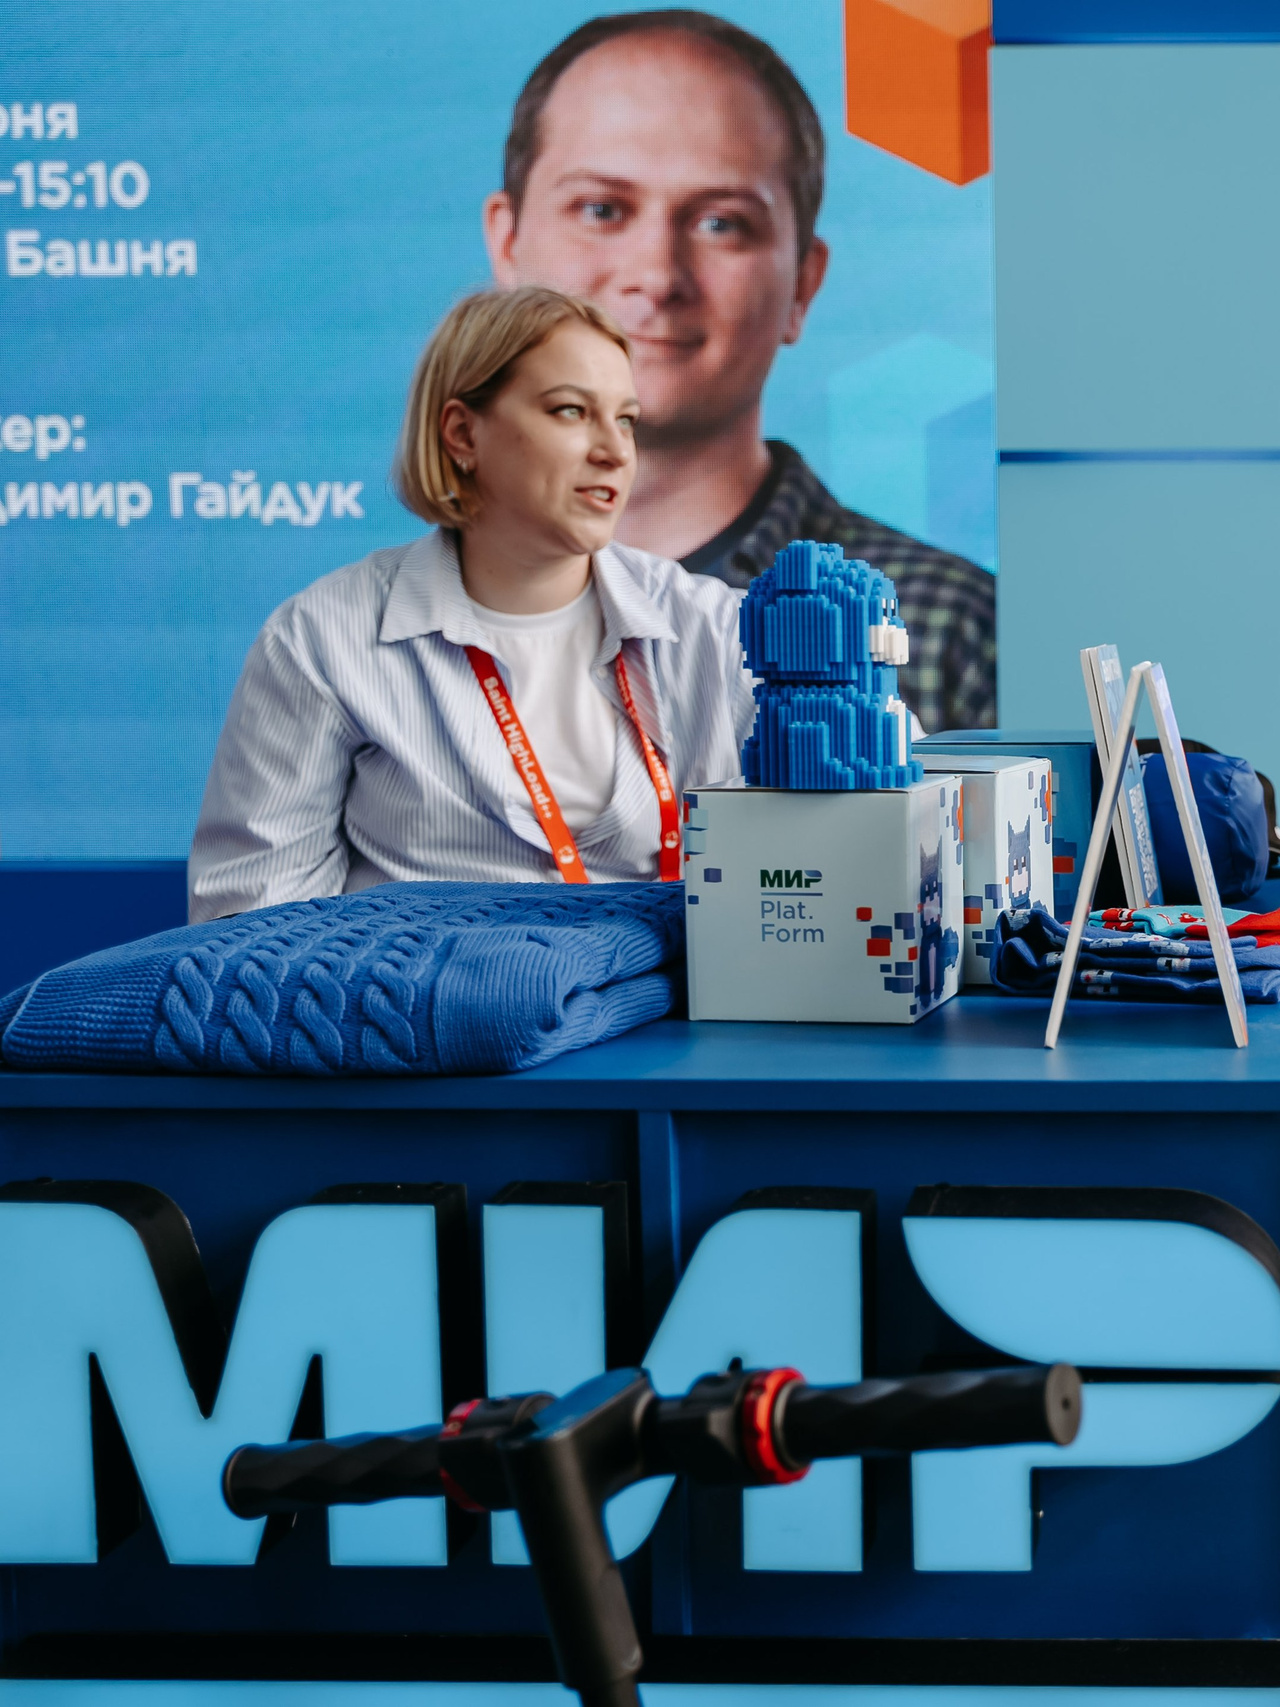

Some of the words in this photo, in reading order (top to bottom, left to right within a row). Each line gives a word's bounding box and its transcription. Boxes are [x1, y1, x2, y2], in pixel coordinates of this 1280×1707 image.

[0, 101, 79, 139] ня
[5, 229, 198, 277] Башня
[0, 413, 87, 461] ер:
[0, 481, 153, 528] имир
[169, 470, 365, 527] Гайдук
[483, 676, 512, 723] Saint
[503, 722, 552, 819] HighLoad++
[760, 869, 823, 888] МИР
[761, 900, 813, 920] Plat.
[761, 923, 825, 943] Form
